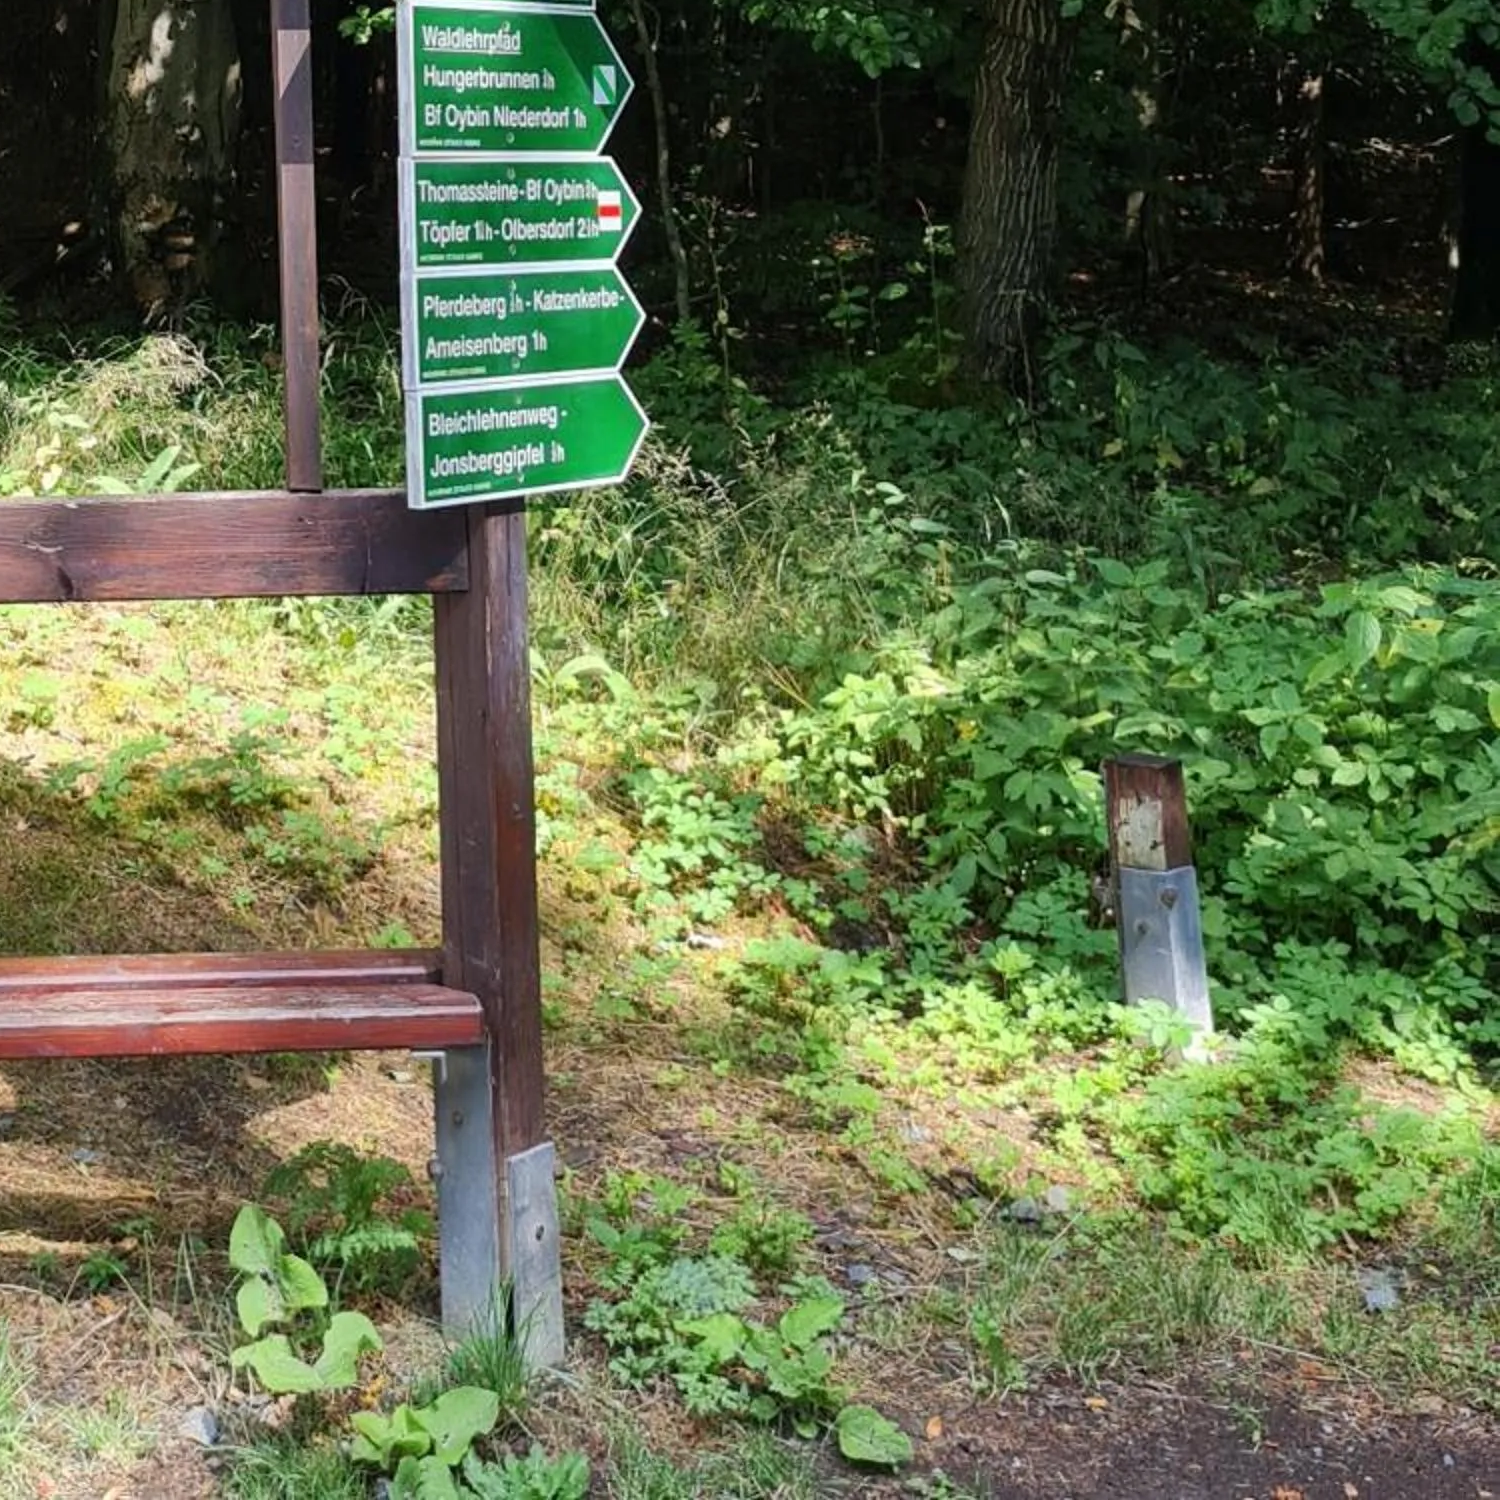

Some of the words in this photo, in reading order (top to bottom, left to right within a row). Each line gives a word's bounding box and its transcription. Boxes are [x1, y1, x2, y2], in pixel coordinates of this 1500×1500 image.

[421, 24, 521, 55] Waldlehrpfad
[423, 64, 540, 93] Hungerbrunnen
[424, 103, 442, 126] Bf
[445, 103, 490, 132] Oybin
[493, 104, 570, 129] Niederdorf
[418, 179, 518, 203] Thomassteine
[526, 179, 542, 200] Bf
[544, 179, 583, 205] Oybin
[419, 220, 470, 248] Töpfer
[501, 217, 574, 241] Olbersdorf
[423, 293, 507, 320] Pferdeberg
[425, 332, 527, 359] Ameisenberg
[429, 405, 558, 437] Bleichlehnenweg
[430, 441, 545, 478] Jonsberggipfel
